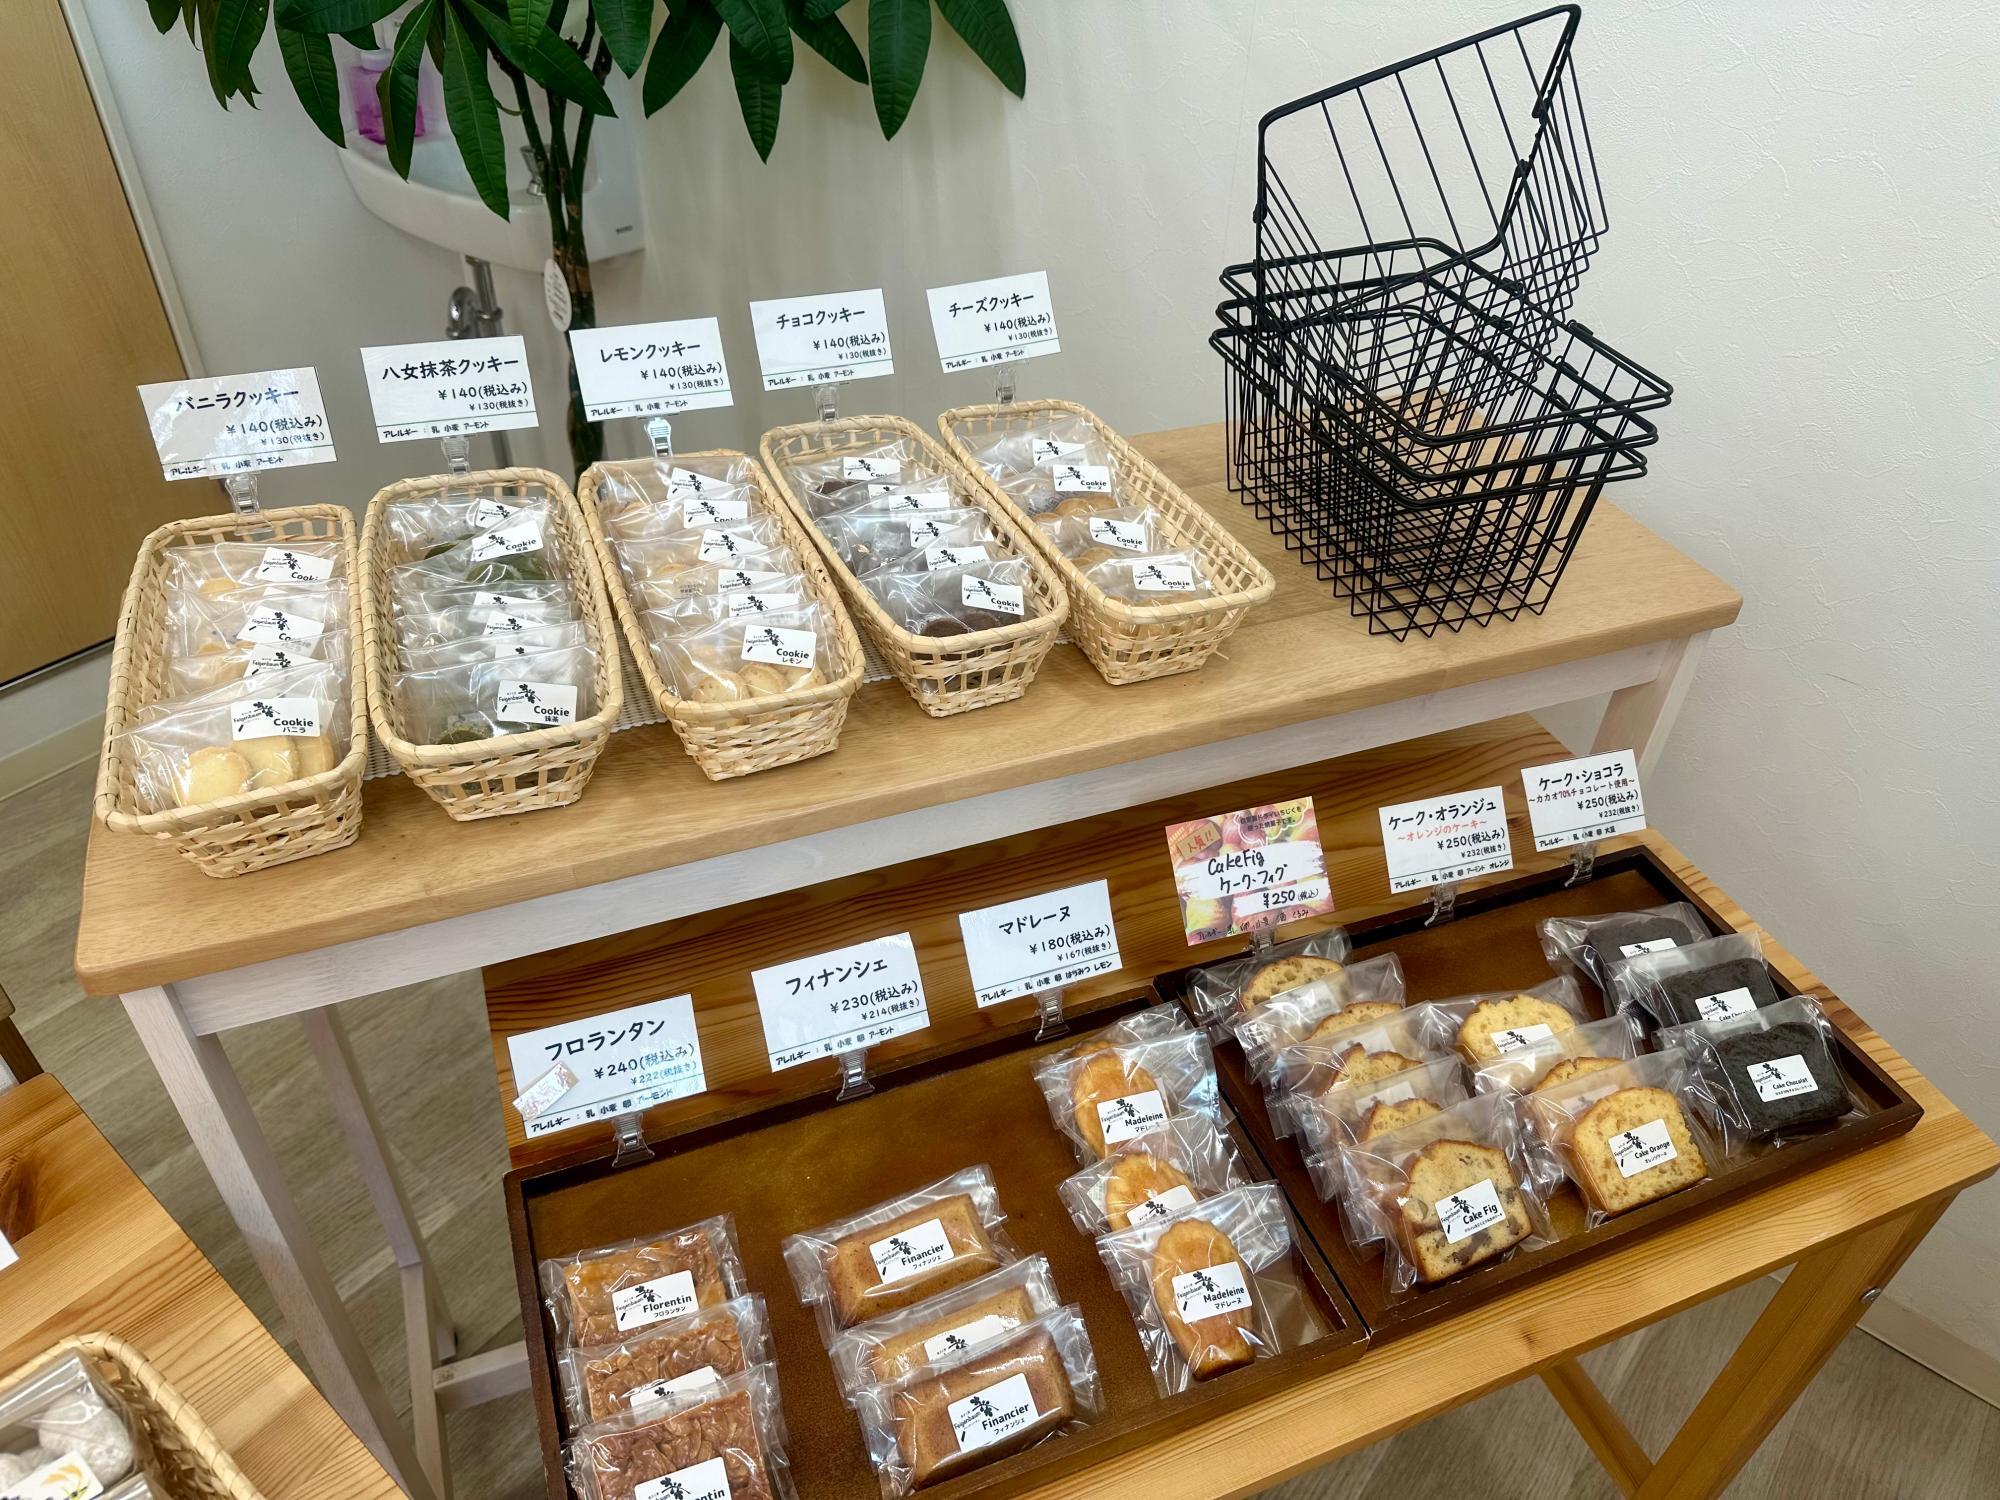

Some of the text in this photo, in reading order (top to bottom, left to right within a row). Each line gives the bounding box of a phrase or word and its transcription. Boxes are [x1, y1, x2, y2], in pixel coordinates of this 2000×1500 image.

[949, 293, 1034, 318] チーズクッキー
[776, 307, 865, 330] チョコクッキー
[984, 312, 1050, 333] ¥140(税込み)
[813, 331, 886, 351] ¥140(税込み)
[600, 341, 701, 363] レモンクッキー
[382, 356, 519, 381] 八女抹茶クッキー
[640, 362, 722, 380] ¥140(税込み)
[946, 359, 971, 369] アレルギー
[669, 377, 724, 390] ¥130(税抜き)
[768, 377, 797, 386] アレルギー
[176, 387, 299, 412] バニラクッキー
[438, 382, 528, 401] ¥140(税込み)
[469, 400, 529, 412] ¥130(税抜き)
[591, 408, 623, 417] アレルギー
[226, 415, 323, 434] ¥140(税込み)
[383, 429, 418, 439] アレルギー
[431, 425, 440, 434] 乳
[171, 466, 207, 476] アレルギー
[1080, 480, 1107, 488] Cookie
[505, 539, 537, 551] Cookie
[1116, 536, 1143, 546] Cookie
[1162, 579, 1190, 588] Cookie
[991, 597, 1020, 608] Cookie
[776, 648, 810, 659] Cookie
[534, 706, 570, 717] Cookie
[273, 717, 314, 728] Cookie
[1539, 762, 1623, 791] ケーク・ショコラ
[1576, 789, 1639, 811] ¥250(税込み)
[1388, 797, 1497, 831] ケーク・オランジュ
[1436, 827, 1505, 850] ¥250(税込み)
[1538, 837, 1564, 848] アレルギー
[1394, 878, 1422, 889] アレルギー
[1263, 890, 1296, 909] ¥250
[998, 905, 1071, 935] マドレーヌ
[1029, 923, 1111, 955] ¥180(税込み)
[1057, 940, 1112, 961] ¥167(税抜き)
[786, 959, 888, 996] フィナンシェ
[980, 988, 1013, 1002] アレルギー
[1094, 960, 1113, 971] レモン
[830, 980, 918, 1014] ¥230(税込み)
[861, 997, 920, 1021] ¥214(税抜き)
[545, 1020, 665, 1062] フロランタン
[594, 1042, 695, 1080] ¥240(税込み)
[775, 1050, 811, 1065] アレルギー
[630, 1060, 698, 1086] ¥222(税抜き)
[531, 1116, 571, 1133] アレルギー
[586, 1108, 595, 1118] 乳
[600, 1103, 617, 1115] 小麦
[1124, 1113, 1164, 1127] Madeleine
[1634, 1141, 1671, 1160] Cake Orange
[1462, 1211, 1483, 1225] Cake
[1483, 1204, 1498, 1216] Fig
[901, 1244, 944, 1267] Financier
[642, 1295, 692, 1313] Florentin
[1203, 1286, 1245, 1303] Madeleine
[1214, 1297, 1242, 1310] マドレーヌ
[981, 1403, 1030, 1431] Financier
